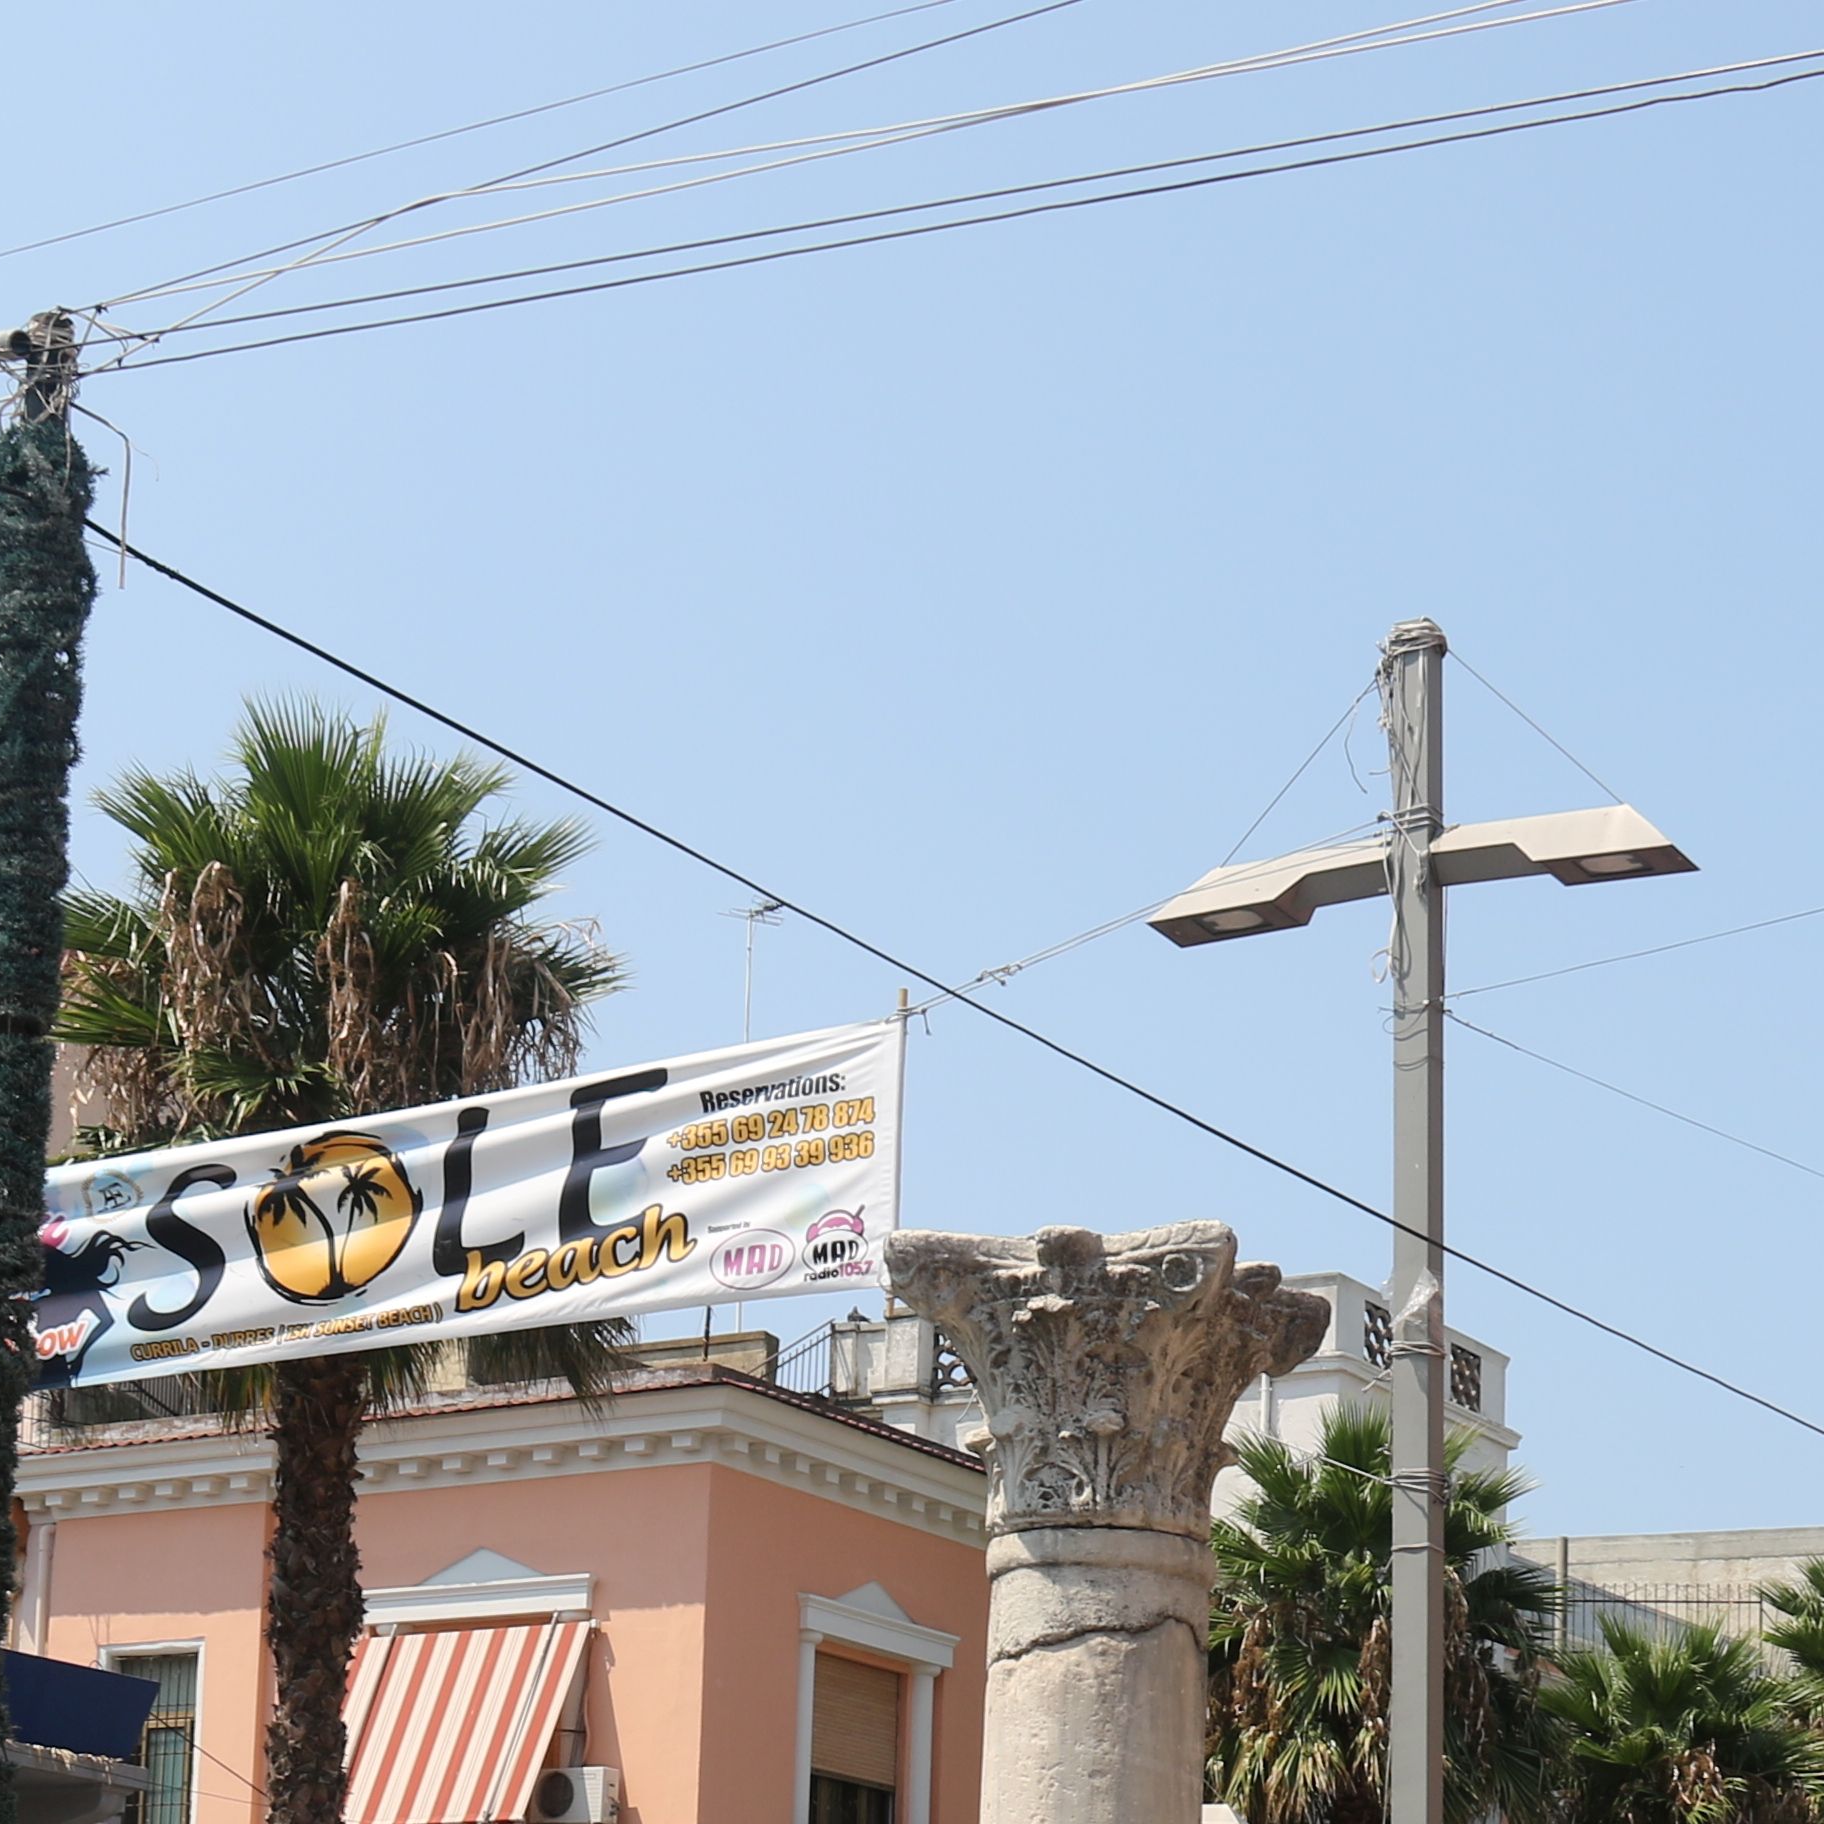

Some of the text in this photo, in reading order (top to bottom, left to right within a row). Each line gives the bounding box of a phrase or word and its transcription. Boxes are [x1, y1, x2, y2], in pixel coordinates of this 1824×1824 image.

[699, 1072, 846, 1113] Reservations:
[667, 1096, 876, 1150] +355 69 24 78 874
[667, 1130, 874, 1185] +355 69 93 39 936
[454, 1203, 697, 1313] beach
[723, 1243, 784, 1277] MAD
[812, 1240, 859, 1265] MAD
[130, 1338, 199, 1361] CURRILA
[211, 1328, 275, 1350] DURRES
[313, 1312, 375, 1336] SUNSET
